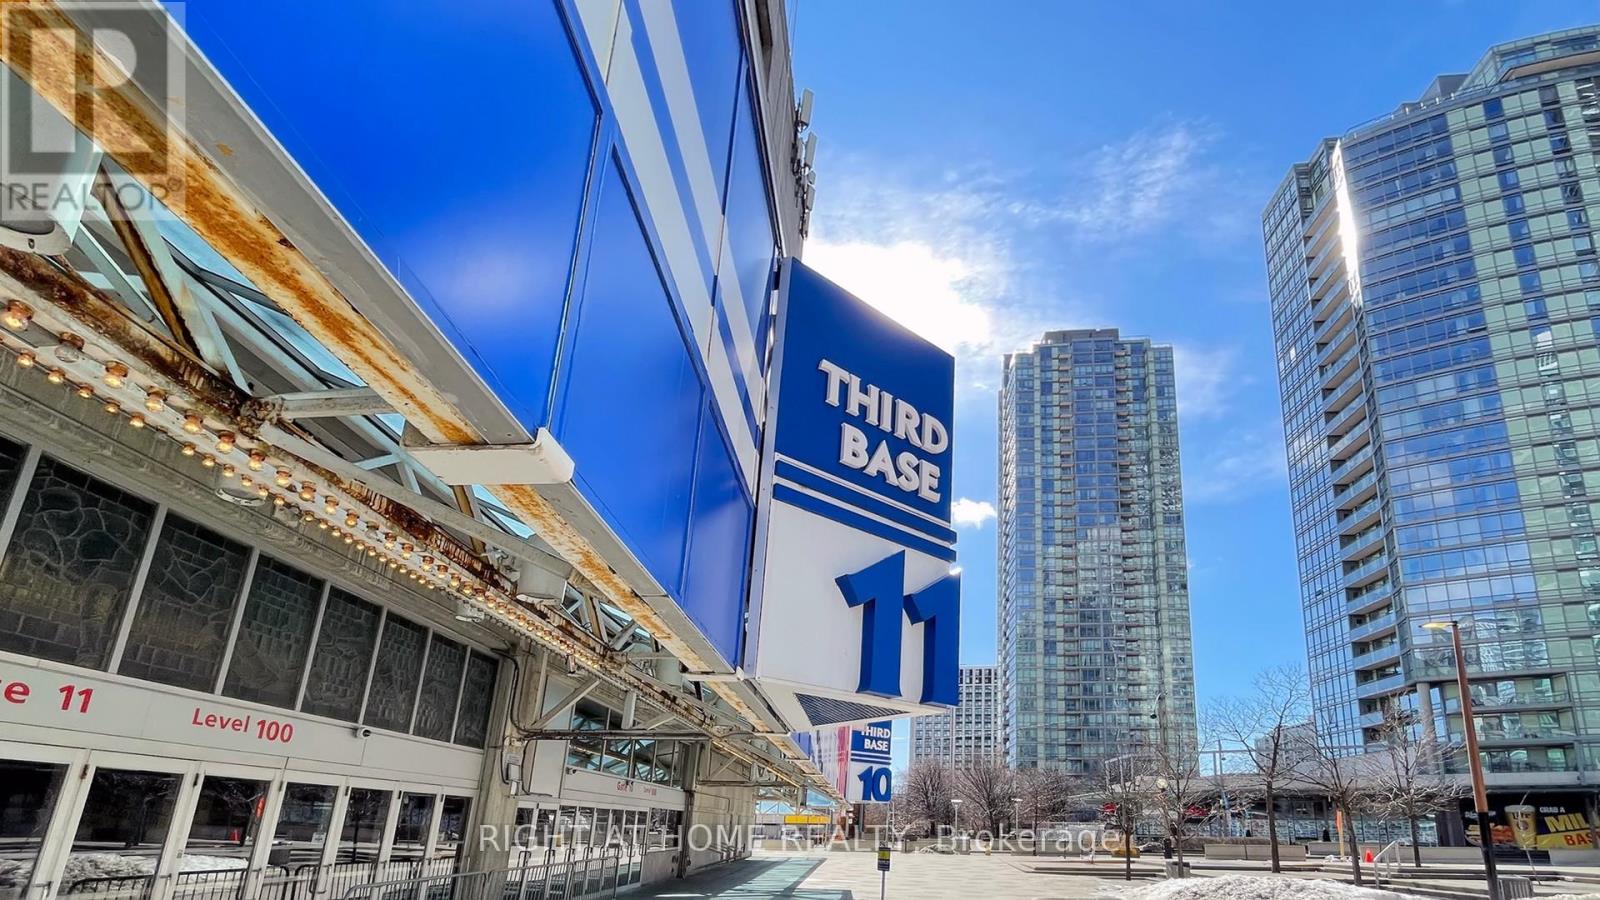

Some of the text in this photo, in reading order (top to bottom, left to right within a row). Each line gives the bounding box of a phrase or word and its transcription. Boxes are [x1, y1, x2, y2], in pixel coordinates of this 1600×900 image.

[818, 358, 949, 455] THIRD
[839, 422, 941, 504] BASE
[835, 549, 961, 706] 11
[59, 685, 93, 713] 11
[192, 708, 294, 743] Level 100
[861, 726, 891, 739] THIRD
[864, 738, 889, 751] BASE
[857, 765, 892, 802] 10
[1563, 831, 1600, 846] BAS
